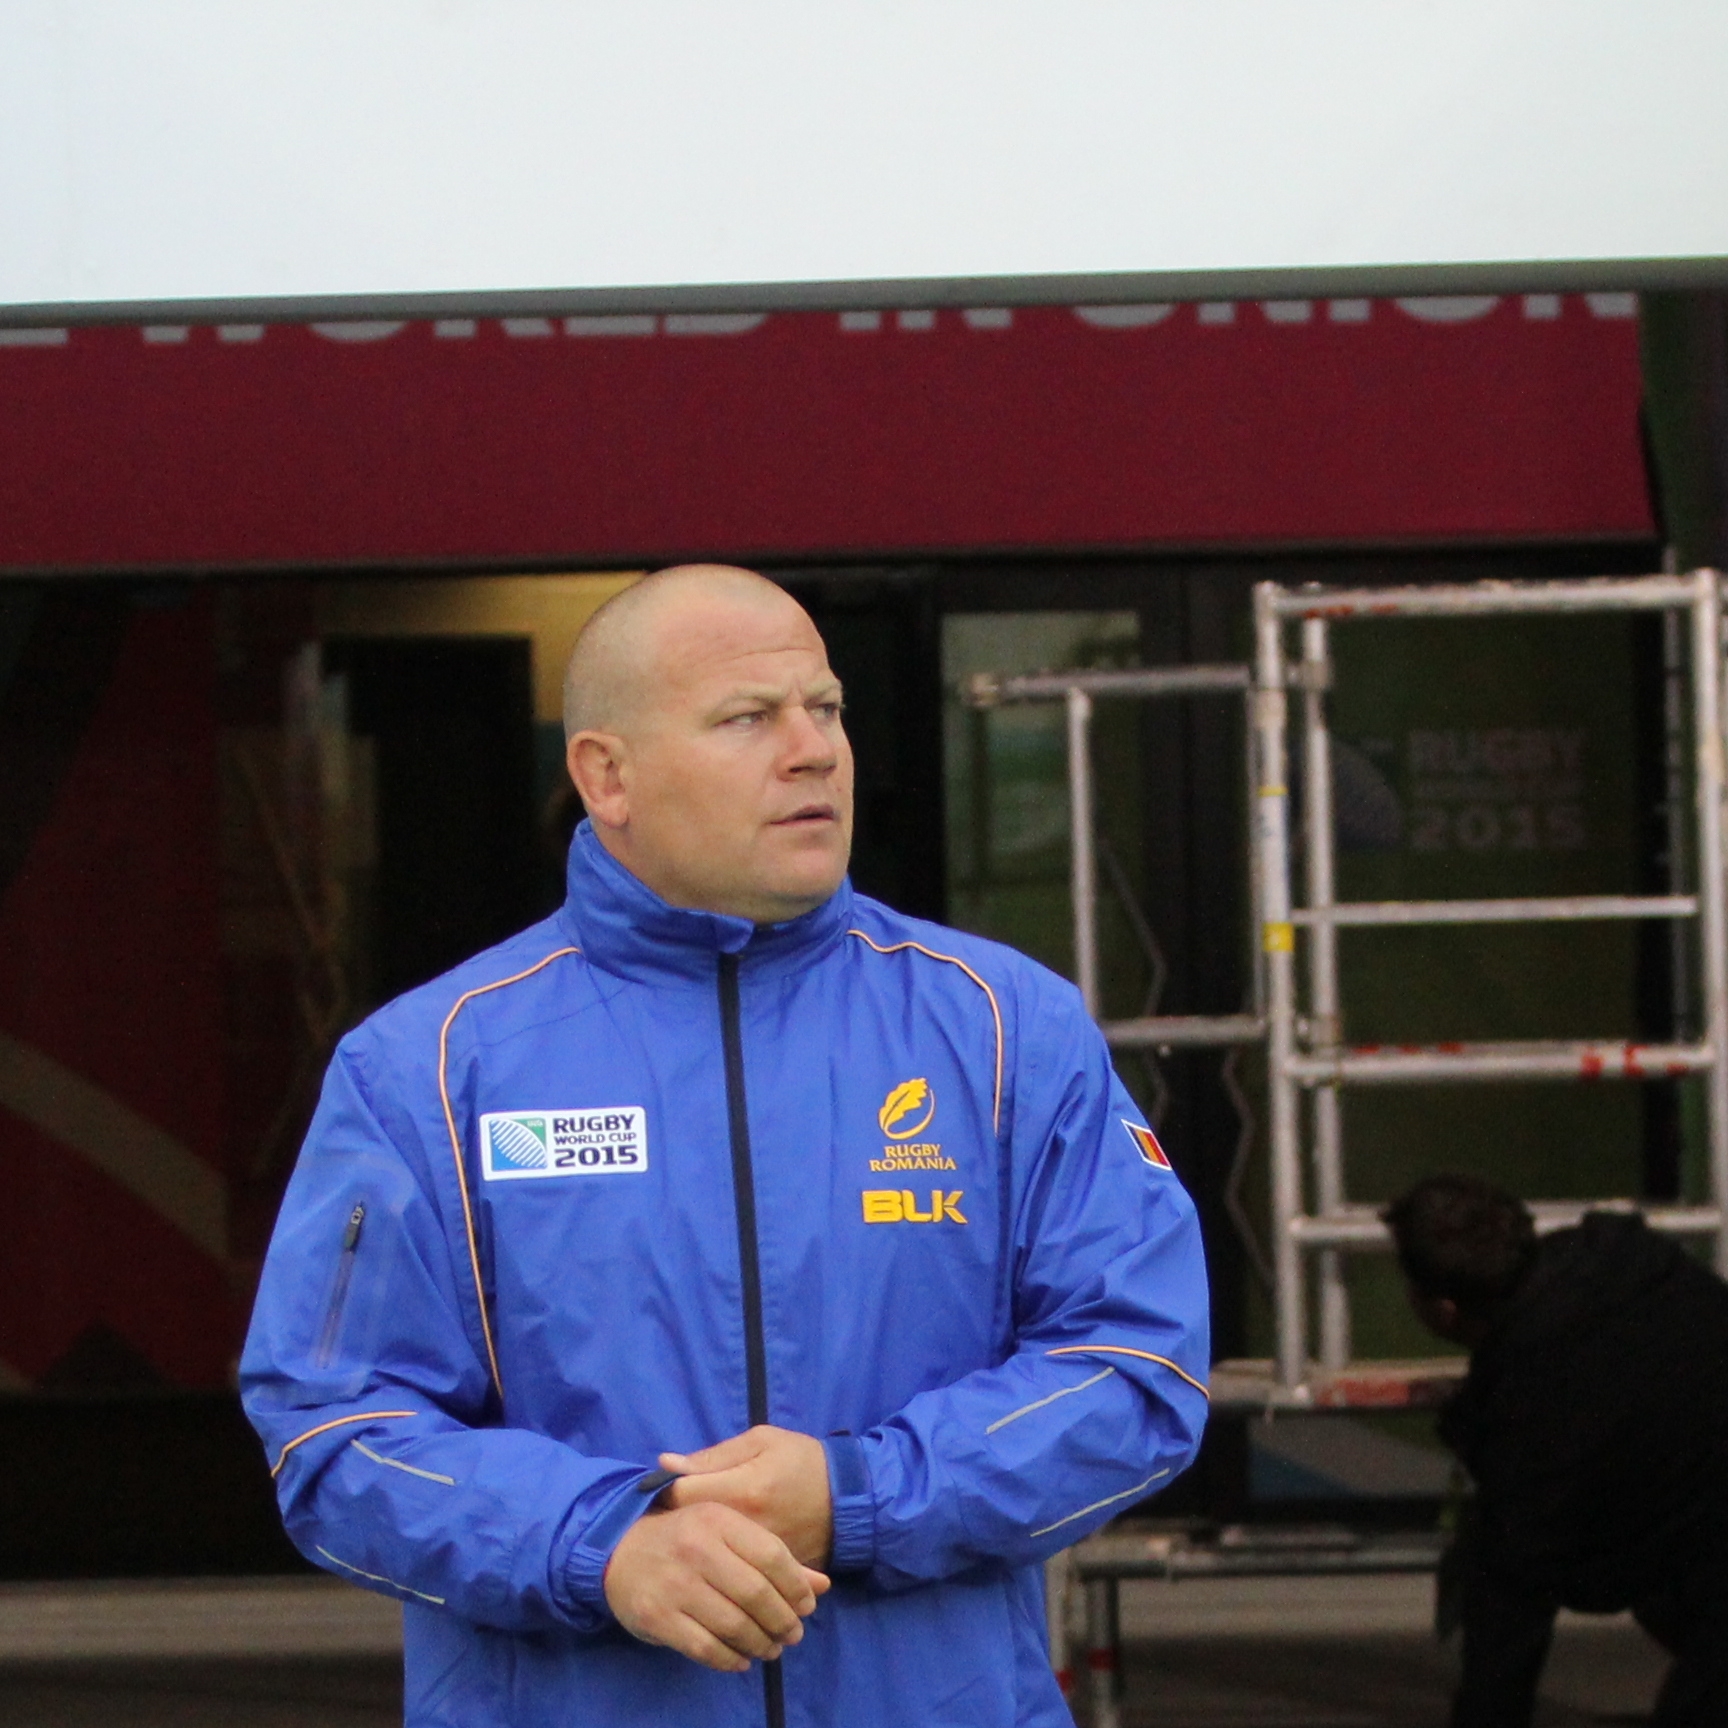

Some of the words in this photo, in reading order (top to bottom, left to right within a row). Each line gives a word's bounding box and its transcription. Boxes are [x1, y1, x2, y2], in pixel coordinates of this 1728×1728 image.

[1409, 803, 1587, 853] 2015
[553, 1113, 636, 1134] RUGBY
[554, 1133, 606, 1145] WORLD
[608, 1132, 637, 1143] CUP
[554, 1144, 639, 1168] 2015
[884, 1143, 942, 1158] RUGBY
[869, 1156, 957, 1172] ROMANIA
[861, 1189, 969, 1224] BLK
